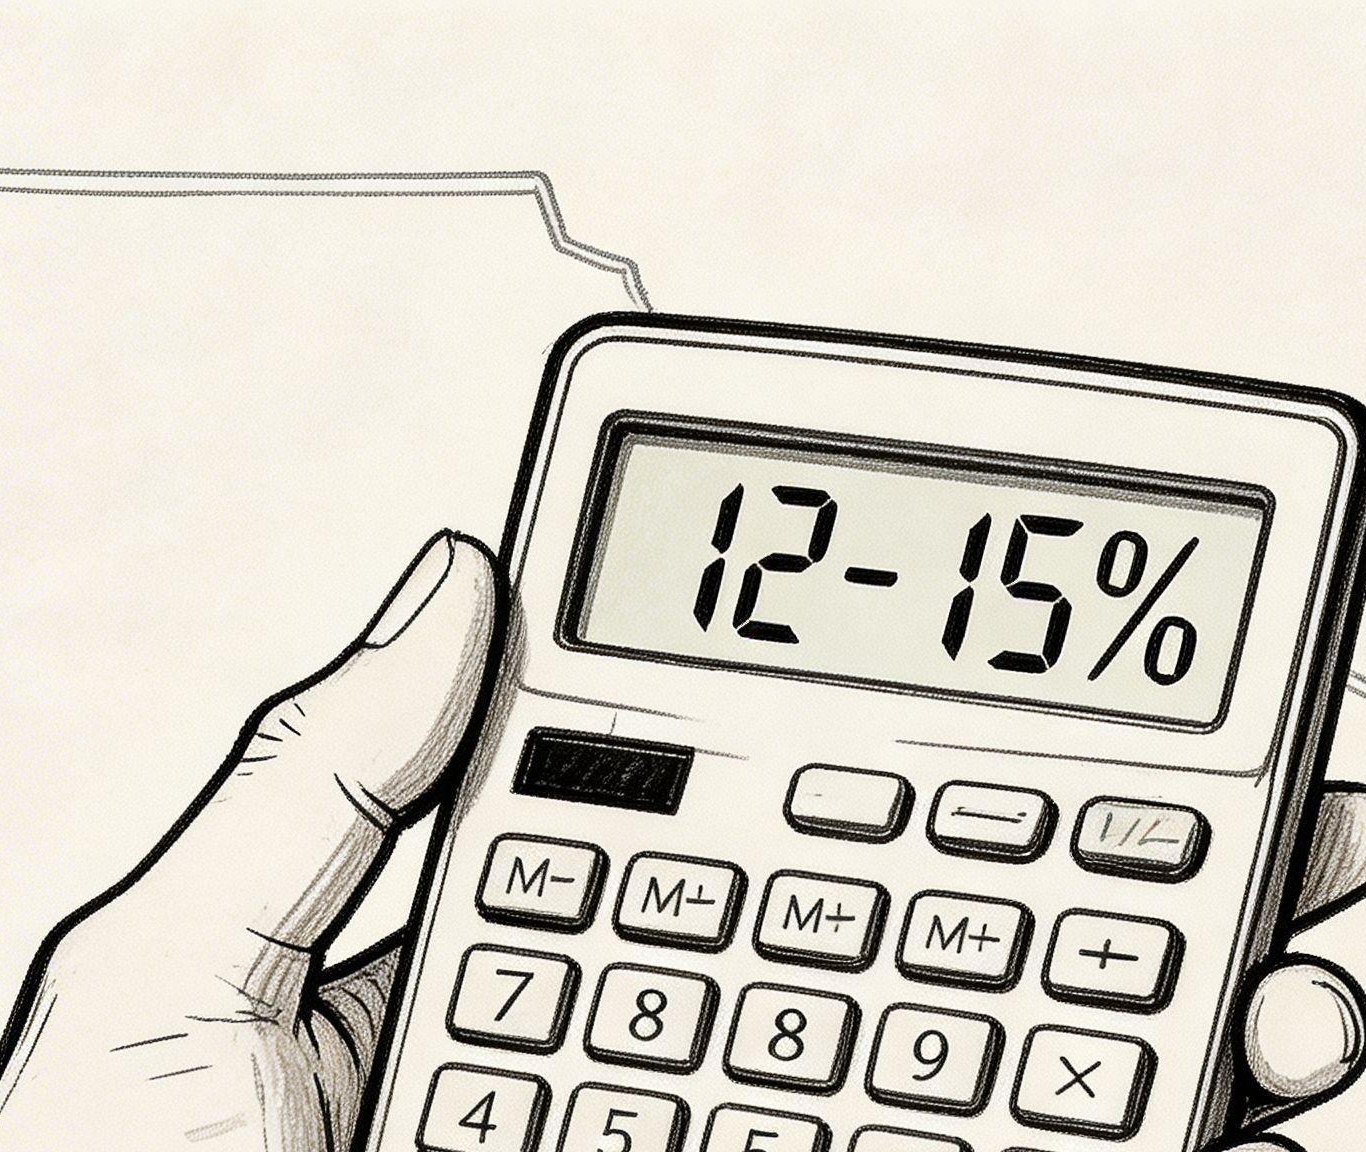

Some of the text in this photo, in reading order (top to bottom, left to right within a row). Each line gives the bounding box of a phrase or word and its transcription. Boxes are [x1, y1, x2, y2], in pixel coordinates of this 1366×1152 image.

[693, 483, 1201, 687] 12-15%
[505, 856, 576, 898] M-
[925, 914, 1001, 954] M+
[493, 968, 535, 1022] 7
[628, 988, 668, 1042] 8
[767, 1008, 808, 1062] 8
[912, 1029, 949, 1082] 9
[458, 1090, 497, 1144] 4
